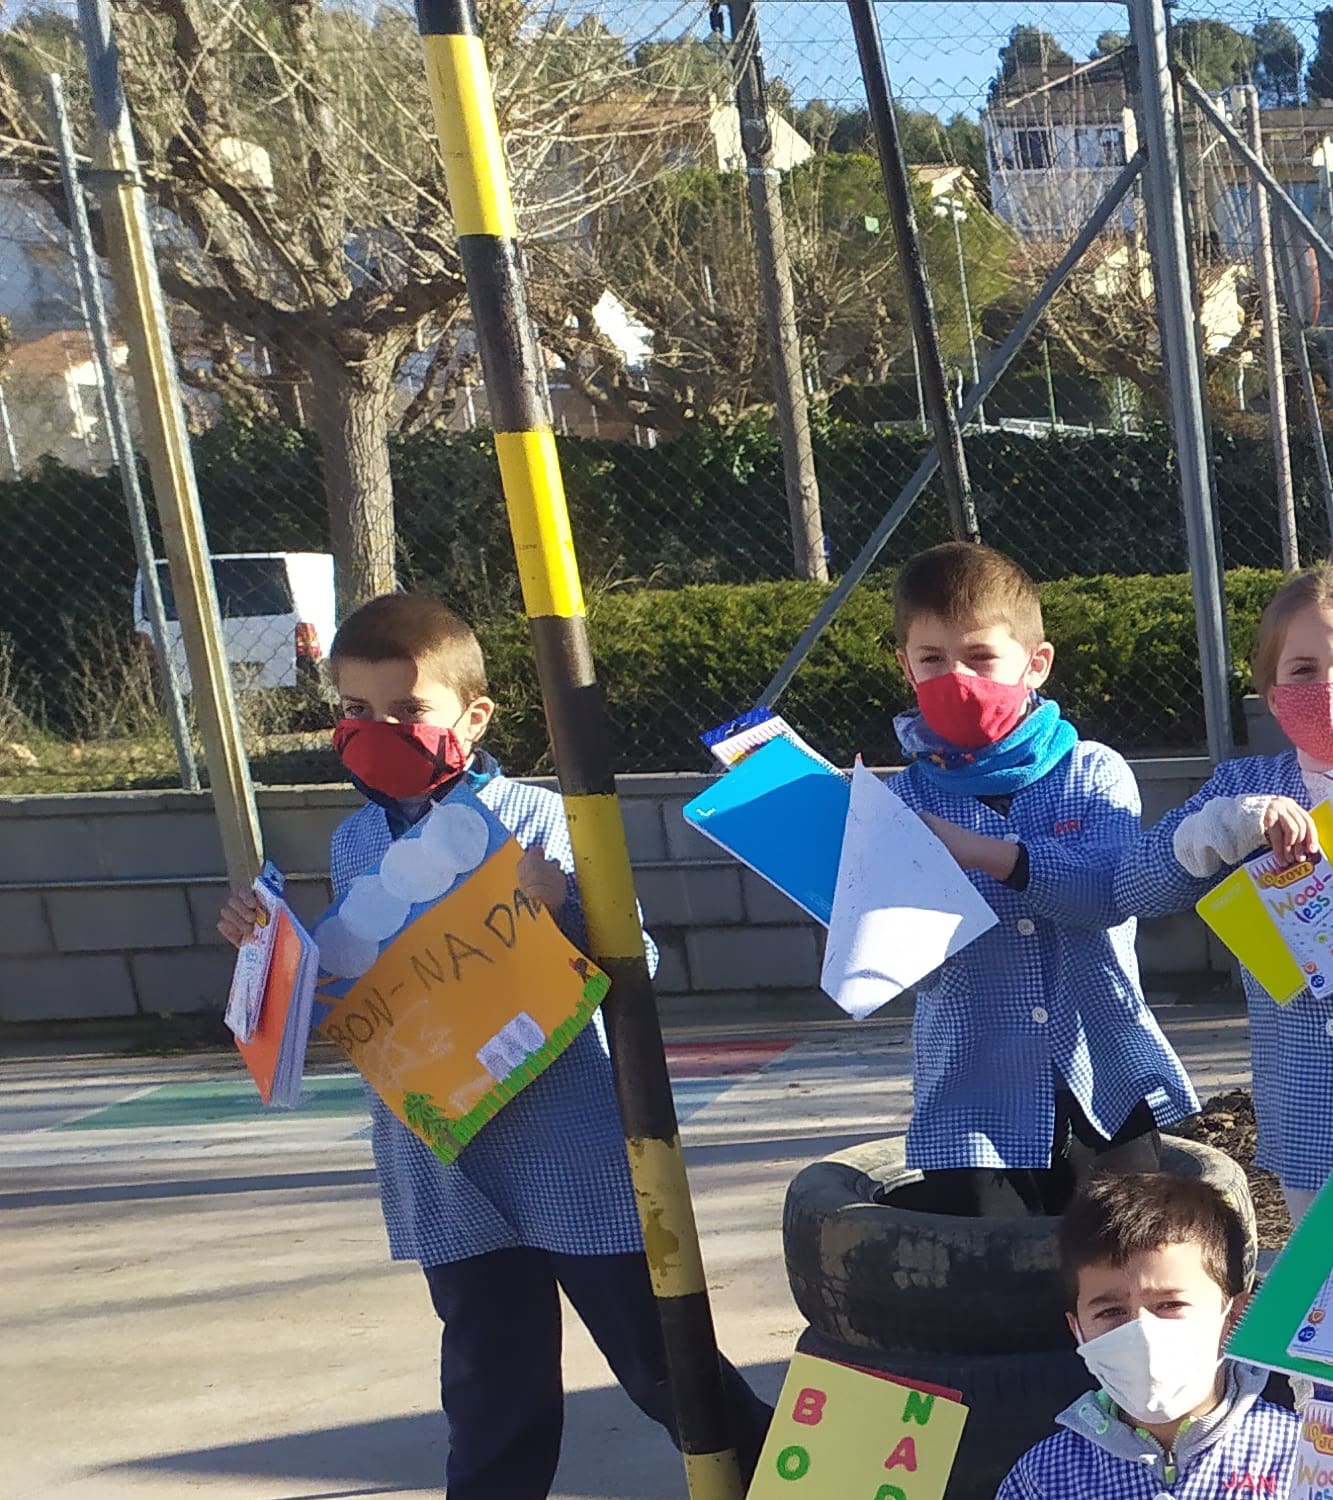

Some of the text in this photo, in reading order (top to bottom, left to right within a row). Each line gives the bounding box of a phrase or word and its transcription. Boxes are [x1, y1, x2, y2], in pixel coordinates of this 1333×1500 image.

[1278, 864, 1312, 885] JOVI
[1268, 873, 1333, 919] Wood-
[1295, 894, 1331, 924] less
[1223, 1471, 1277, 1494] JAN
